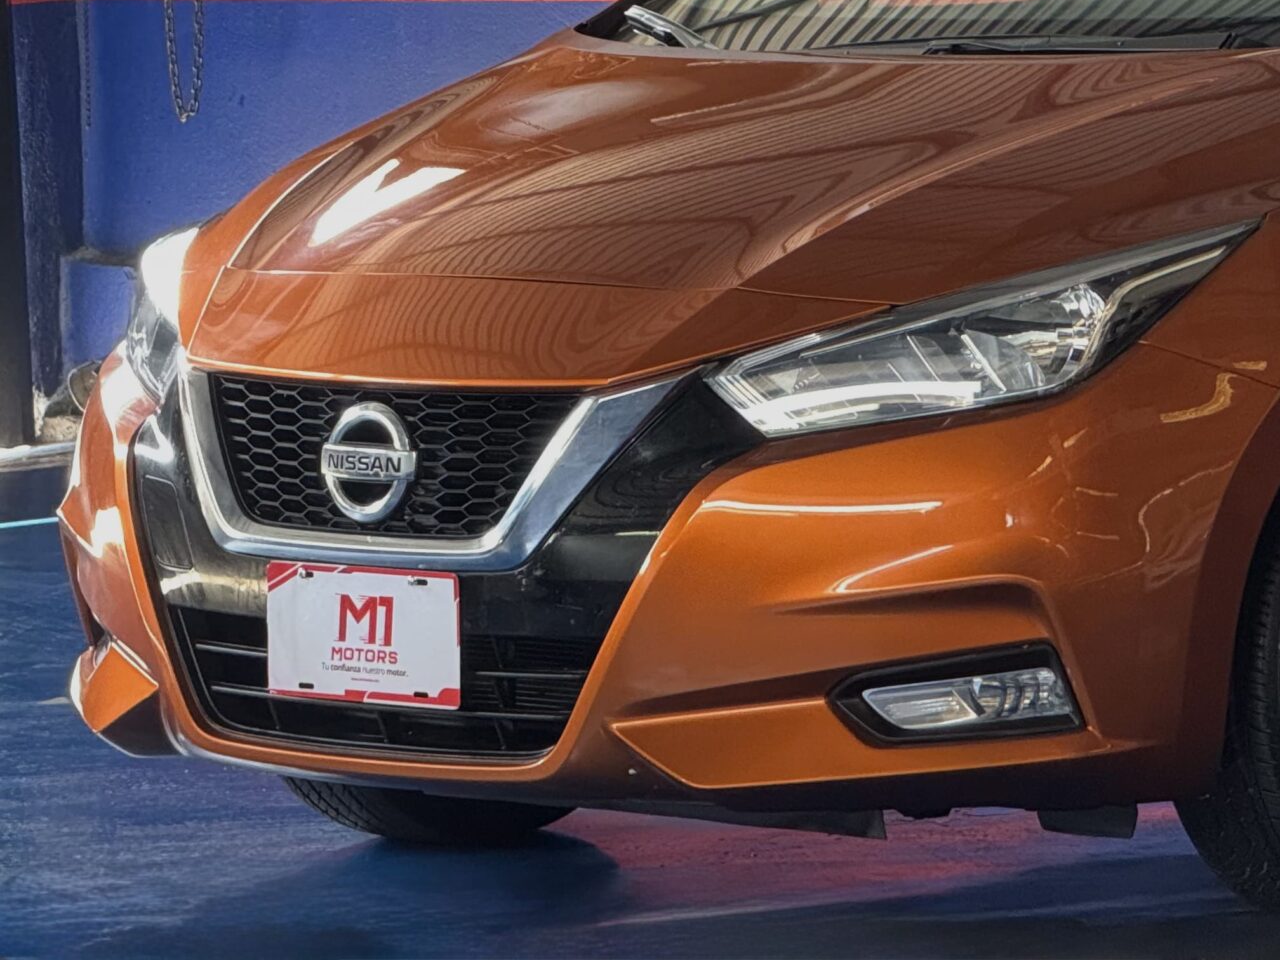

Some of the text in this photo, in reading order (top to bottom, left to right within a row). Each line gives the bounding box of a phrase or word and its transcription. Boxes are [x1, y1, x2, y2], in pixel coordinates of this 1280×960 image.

[328, 453, 402, 473] NISSAN
[335, 593, 394, 647] M1
[331, 646, 398, 665] MOTORS
[321, 662, 409, 677] Tu confianza nuestro motor.
